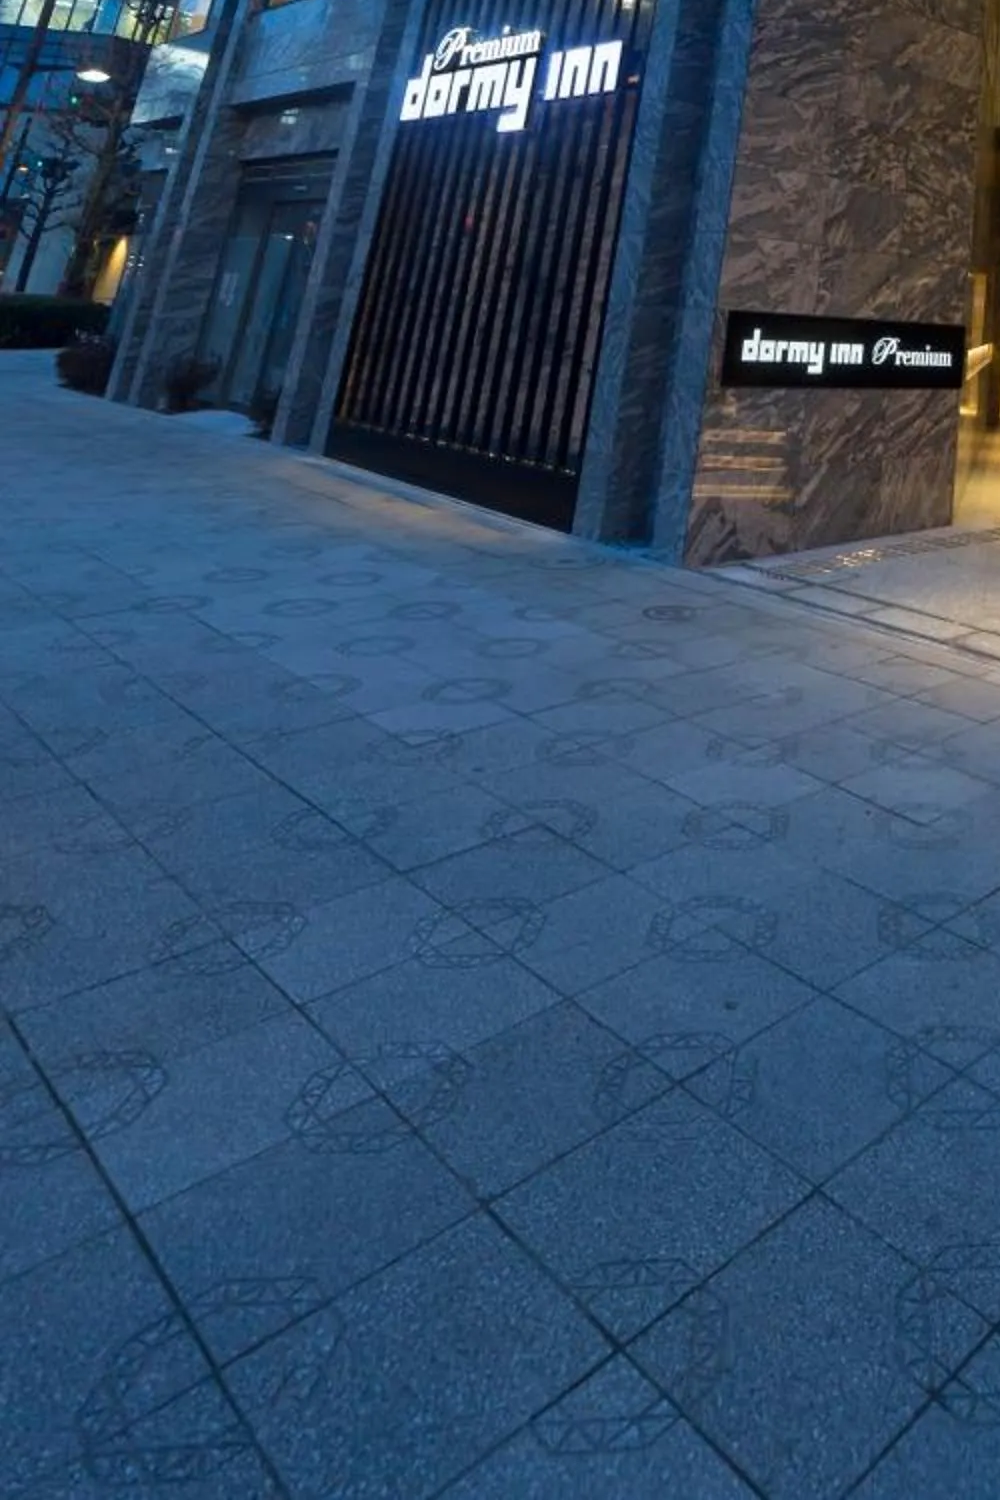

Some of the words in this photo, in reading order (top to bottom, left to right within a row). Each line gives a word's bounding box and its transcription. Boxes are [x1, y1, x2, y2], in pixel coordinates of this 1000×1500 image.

[433, 26, 542, 70] Premium
[400, 54, 537, 133] dormy
[543, 40, 623, 101] inn
[741, 328, 825, 374] dormy
[830, 343, 864, 364] inn
[871, 337, 952, 367] Premium
